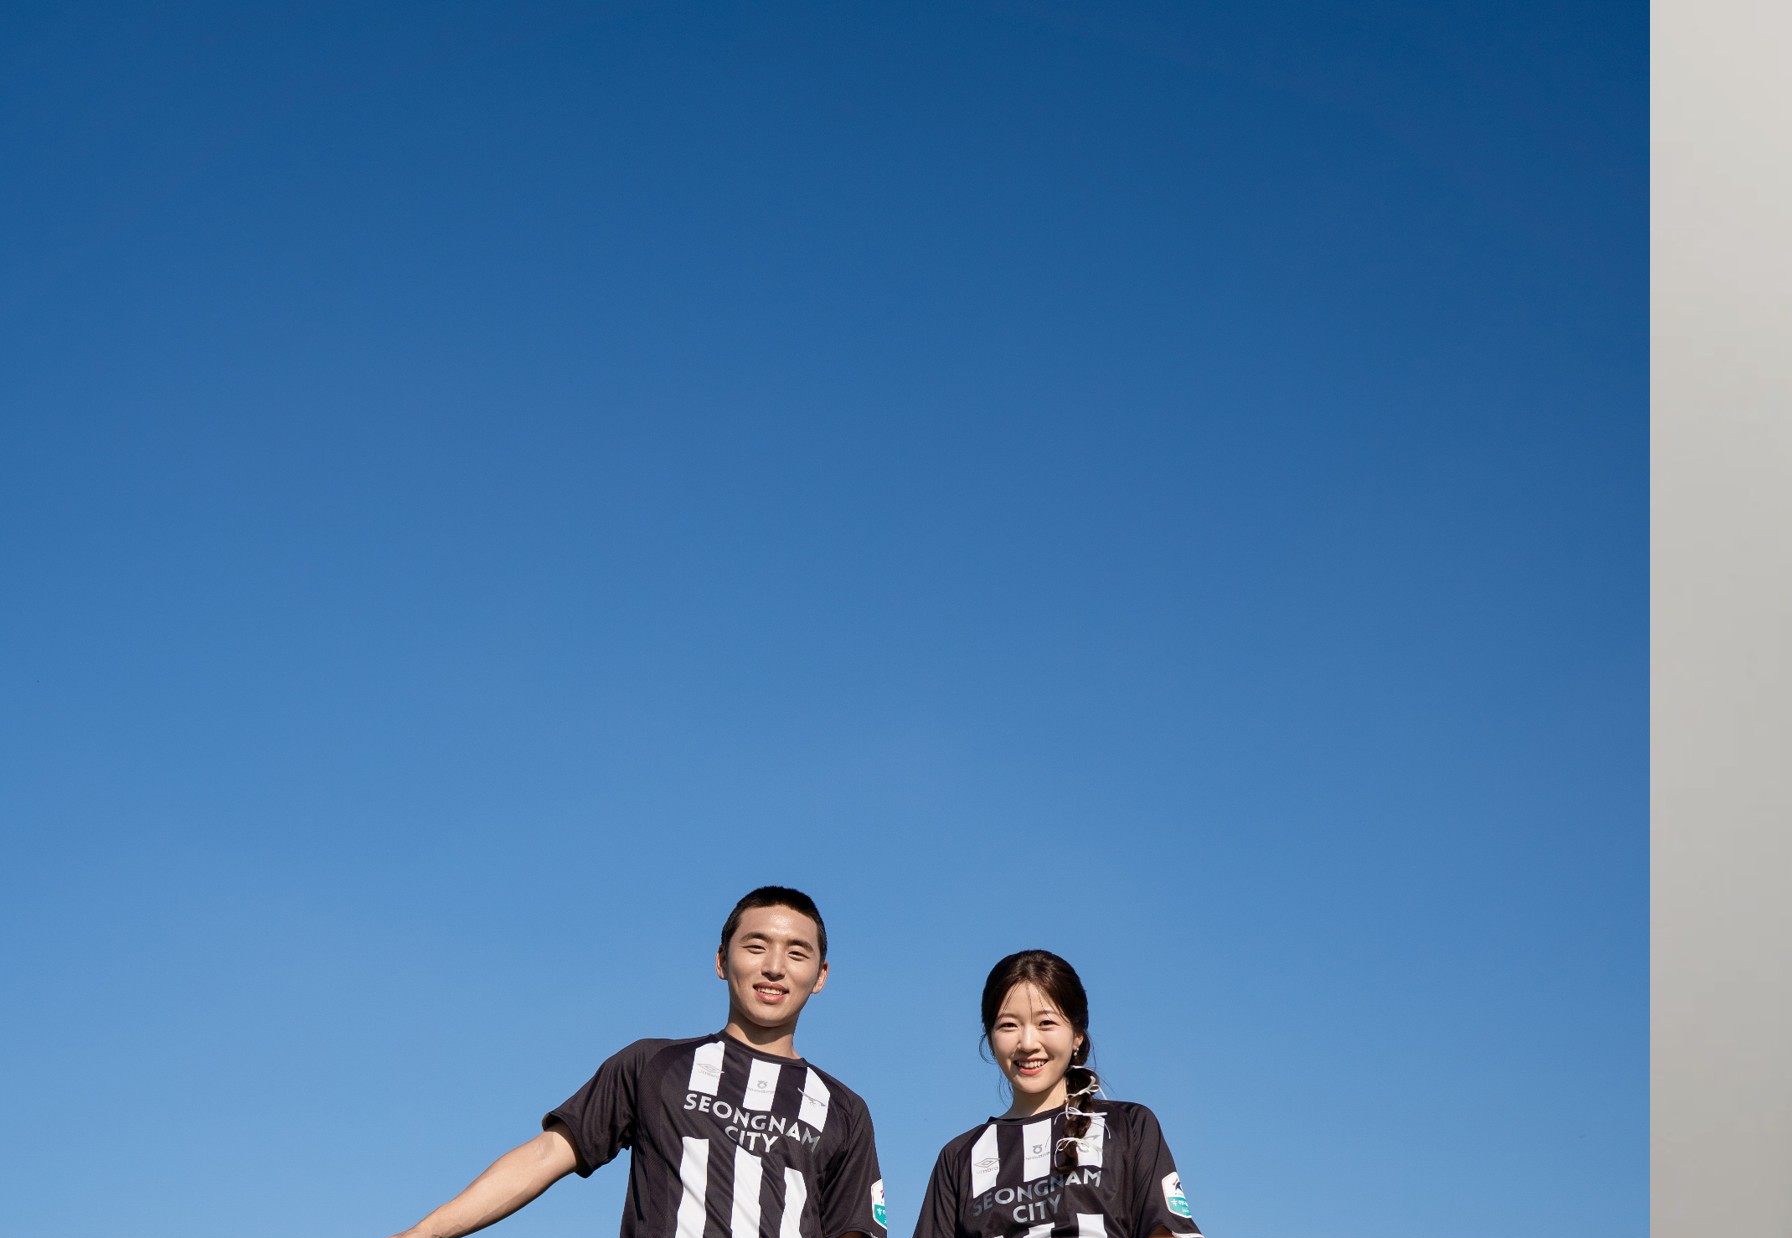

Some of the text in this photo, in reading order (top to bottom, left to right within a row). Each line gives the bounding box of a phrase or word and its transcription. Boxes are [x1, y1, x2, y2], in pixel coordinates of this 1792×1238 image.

[683, 1093, 821, 1153] SEONGNAM
[724, 1125, 779, 1153] CITY
[972, 1168, 1102, 1217] SEONGNAM
[1012, 1193, 1061, 1223] CITY
